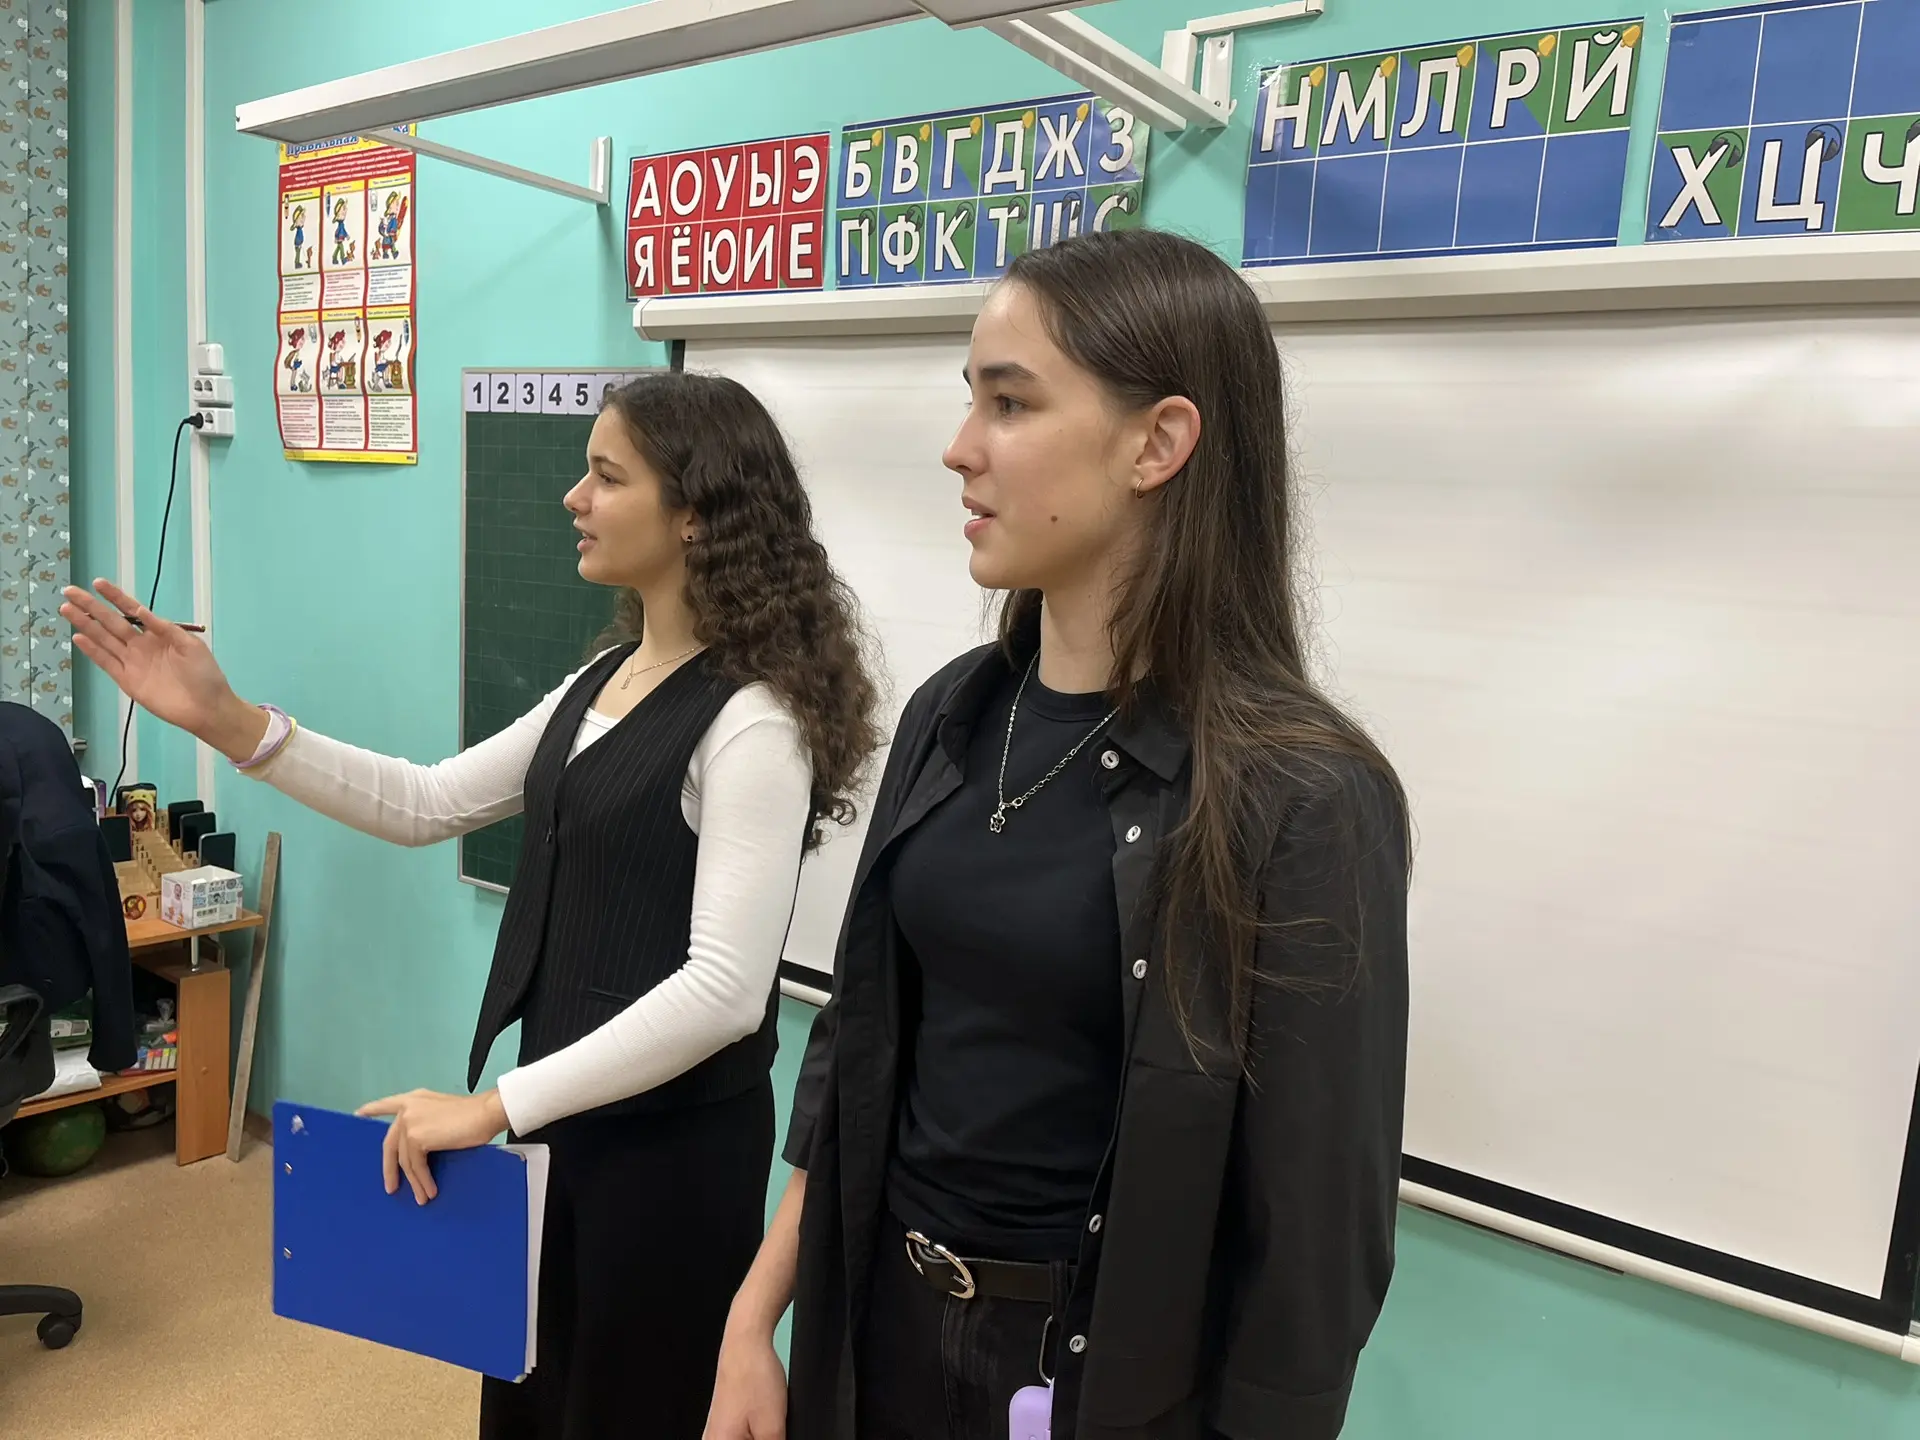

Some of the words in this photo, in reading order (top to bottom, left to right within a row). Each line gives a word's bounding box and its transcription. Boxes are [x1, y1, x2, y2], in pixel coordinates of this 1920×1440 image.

[1259, 70, 1312, 153] Н
[1320, 66, 1388, 147] М
[1399, 57, 1463, 138] Л
[1489, 47, 1542, 130] Р
[1564, 30, 1636, 123] Й
[631, 165, 662, 220] А
[669, 159, 703, 216] О
[711, 154, 739, 211] У
[748, 148, 783, 208] Ы
[791, 145, 821, 204] Э
[844, 139, 872, 199] Б
[891, 134, 920, 195] В
[942, 126, 973, 190] Г
[983, 119, 1026, 194] Д
[1034, 113, 1085, 181] Ж
[1098, 106, 1135, 173] З
[1658, 143, 1730, 228] Х
[1755, 136, 1826, 231] Ц
[1862, 131, 1920, 216] Ч
[633, 235, 655, 288] Я
[671, 225, 691, 287] Ё
[702, 228, 738, 285] Ю
[743, 224, 775, 283] И
[789, 222, 814, 280] Е
[841, 216, 871, 277] П
[882, 214, 921, 274] Ф
[934, 209, 968, 272] К
[988, 205, 1021, 268] Т
[472, 381, 482, 404] 1
[497, 381, 510, 405] 2
[522, 382, 535, 405] 3
[548, 383, 562, 406] 4
[575, 383, 589, 406] 5
